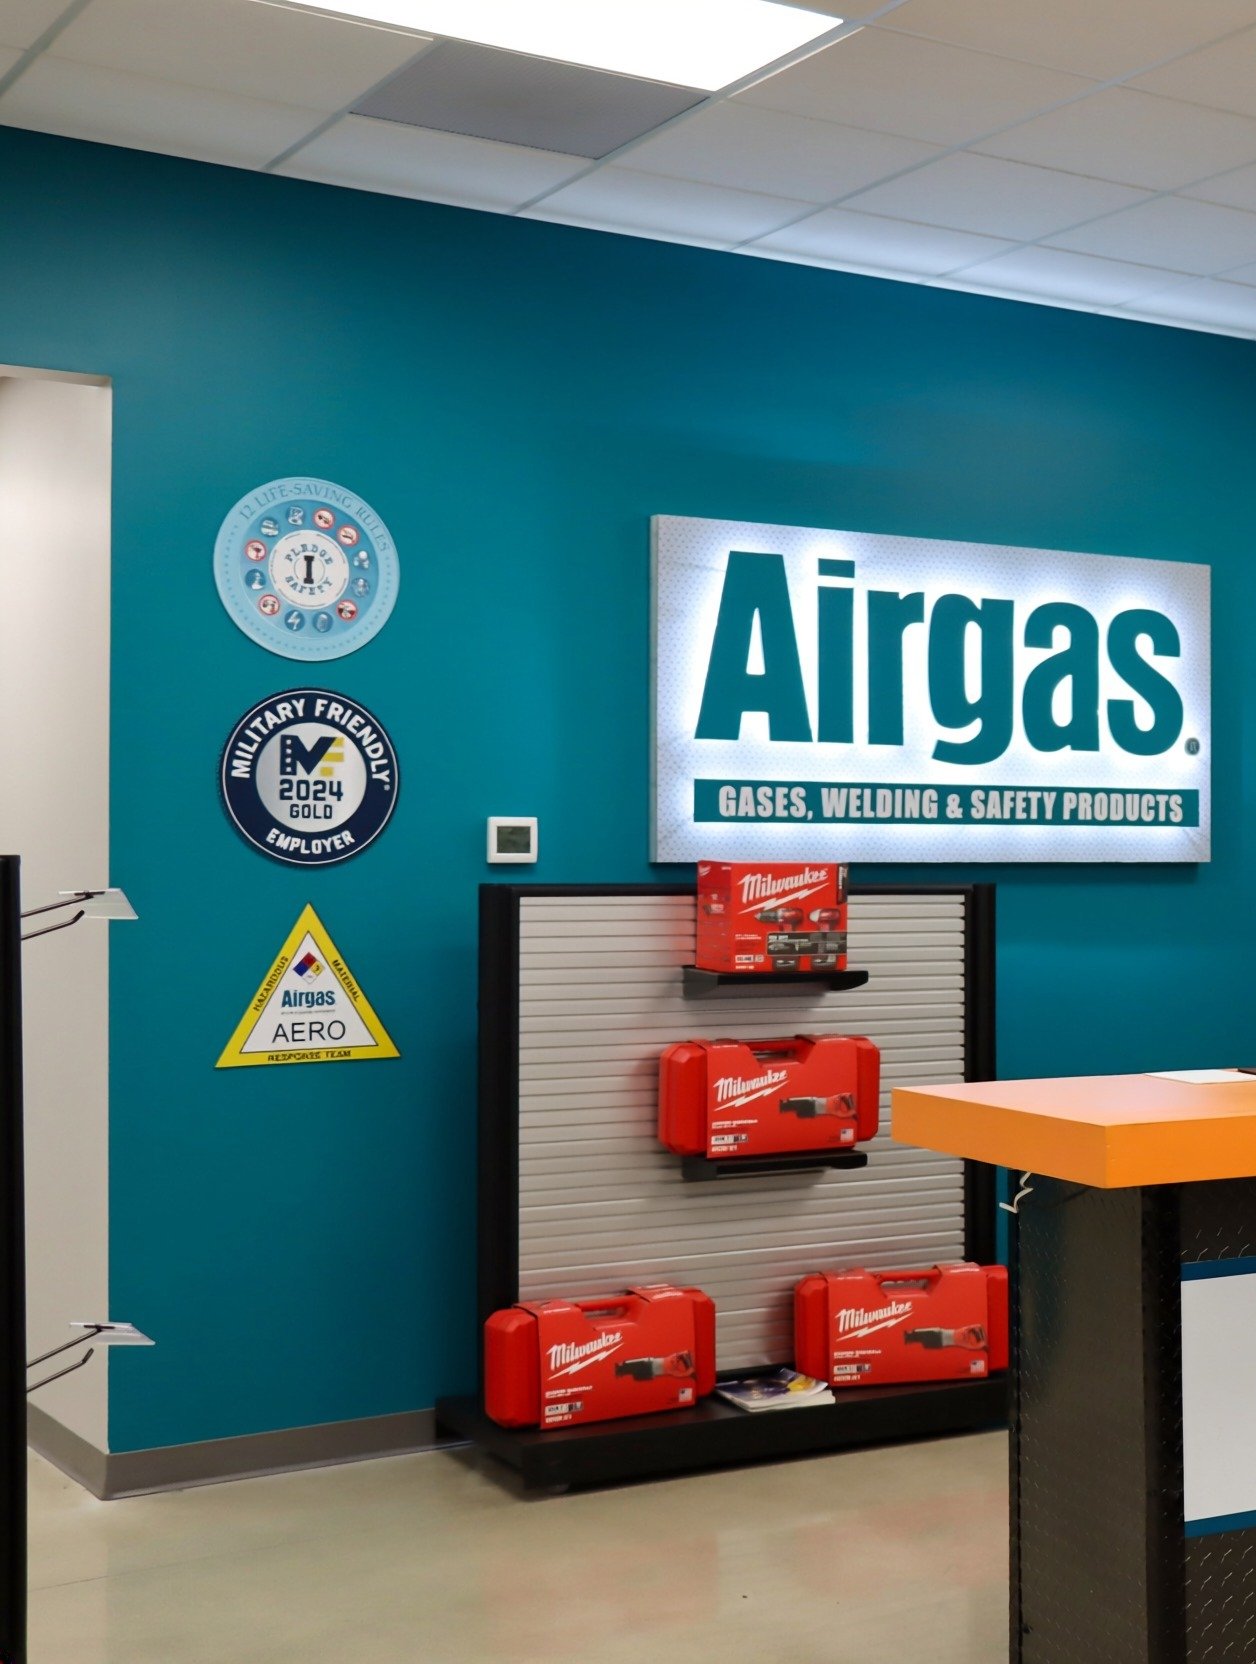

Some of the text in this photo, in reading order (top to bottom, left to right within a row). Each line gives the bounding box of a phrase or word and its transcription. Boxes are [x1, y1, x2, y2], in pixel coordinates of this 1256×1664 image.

[254, 483, 353, 509] LIFE-SAVING
[355, 506, 390, 553] RULES
[285, 576, 333, 596] SAFETY
[694, 550, 1184, 766] Airgas
[231, 698, 305, 779] MILITARY
[279, 779, 343, 802] 2024
[718, 785, 1183, 823] GASES, WELDING & SAFETY PRODUCTS
[290, 804, 333, 820] GOLD
[266, 828, 355, 855] EMPLOYER
[737, 867, 828, 904] Milwaukee
[332, 959, 360, 1003] MATERIAL
[281, 989, 336, 1008] Airgas
[272, 1020, 346, 1043] AERO
[325, 1050, 352, 1059] TEAM
[713, 1069, 788, 1102] Milwaukee
[835, 1301, 913, 1333] Milwaukee
[546, 1331, 622, 1370] Milwaukee
